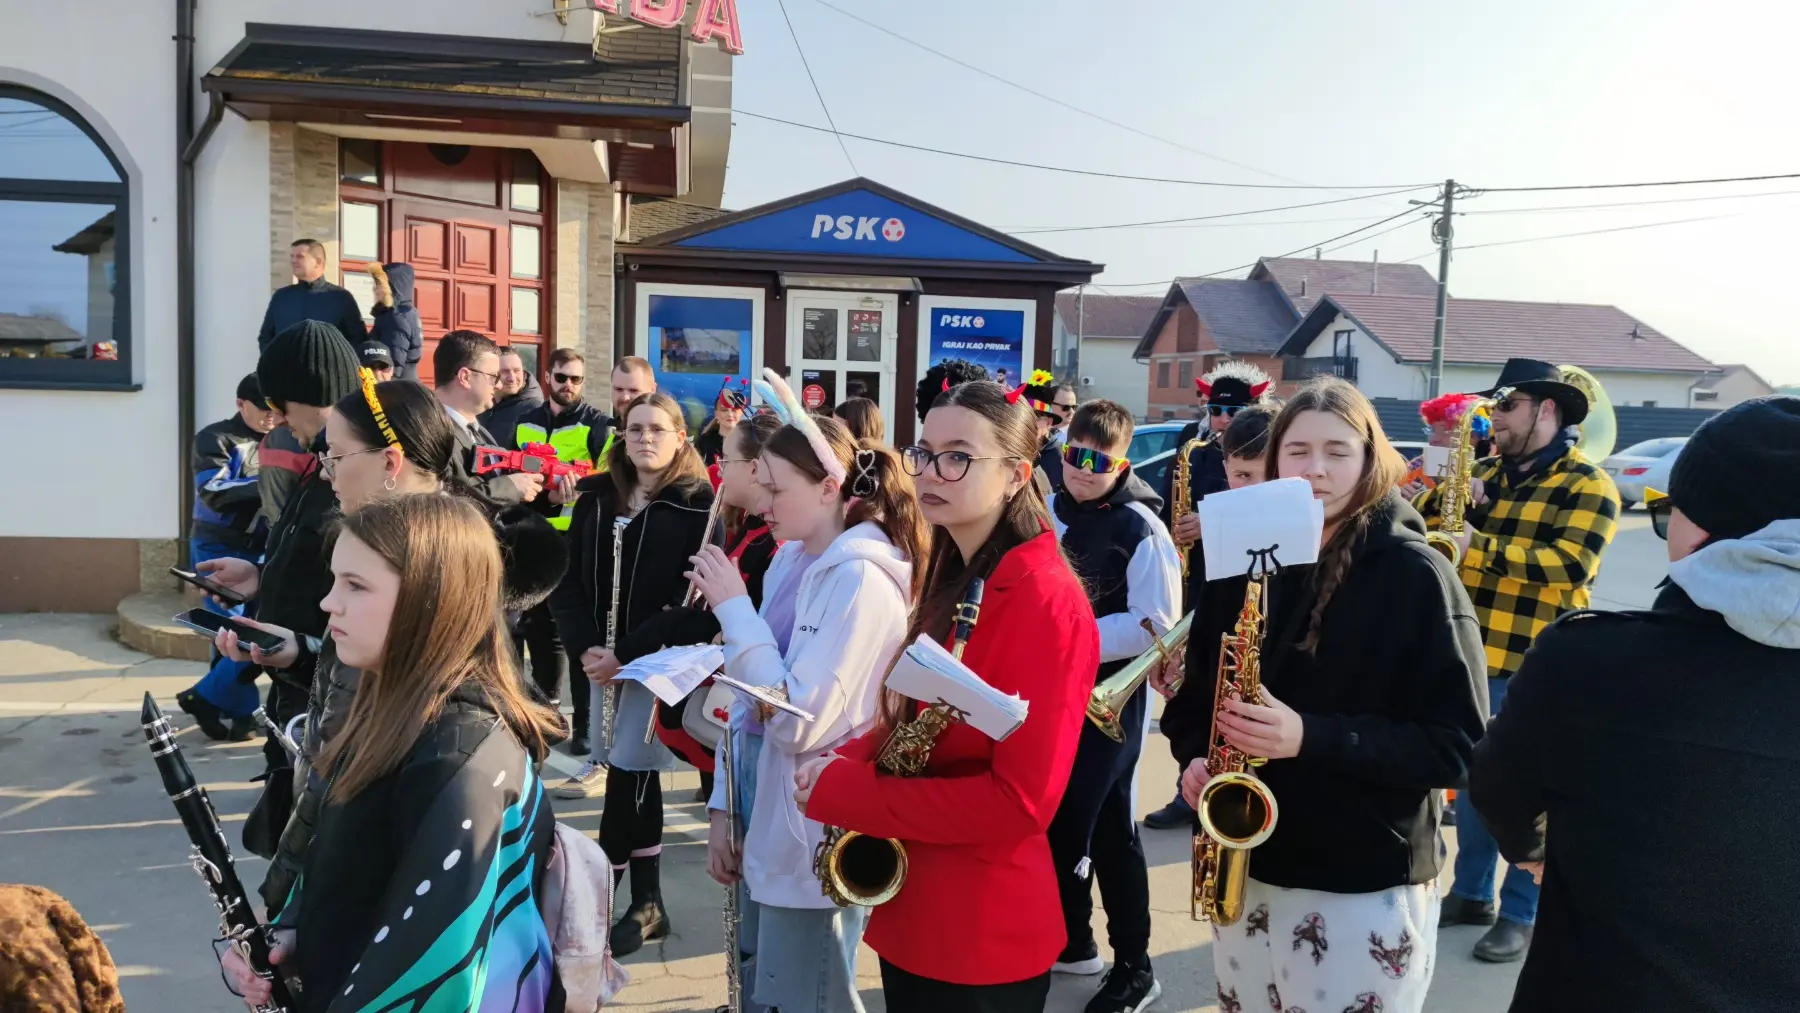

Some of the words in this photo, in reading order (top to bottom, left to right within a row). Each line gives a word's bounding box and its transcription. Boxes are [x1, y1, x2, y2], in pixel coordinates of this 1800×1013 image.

[592, 0, 744, 55] DA
[811, 214, 881, 241] PSK
[940, 314, 973, 328] PSK
[364, 347, 387, 356] POLICE
[942, 341, 965, 349] IGRAJ
[966, 342, 984, 350] KAO
[984, 343, 1011, 351] PRVAK
